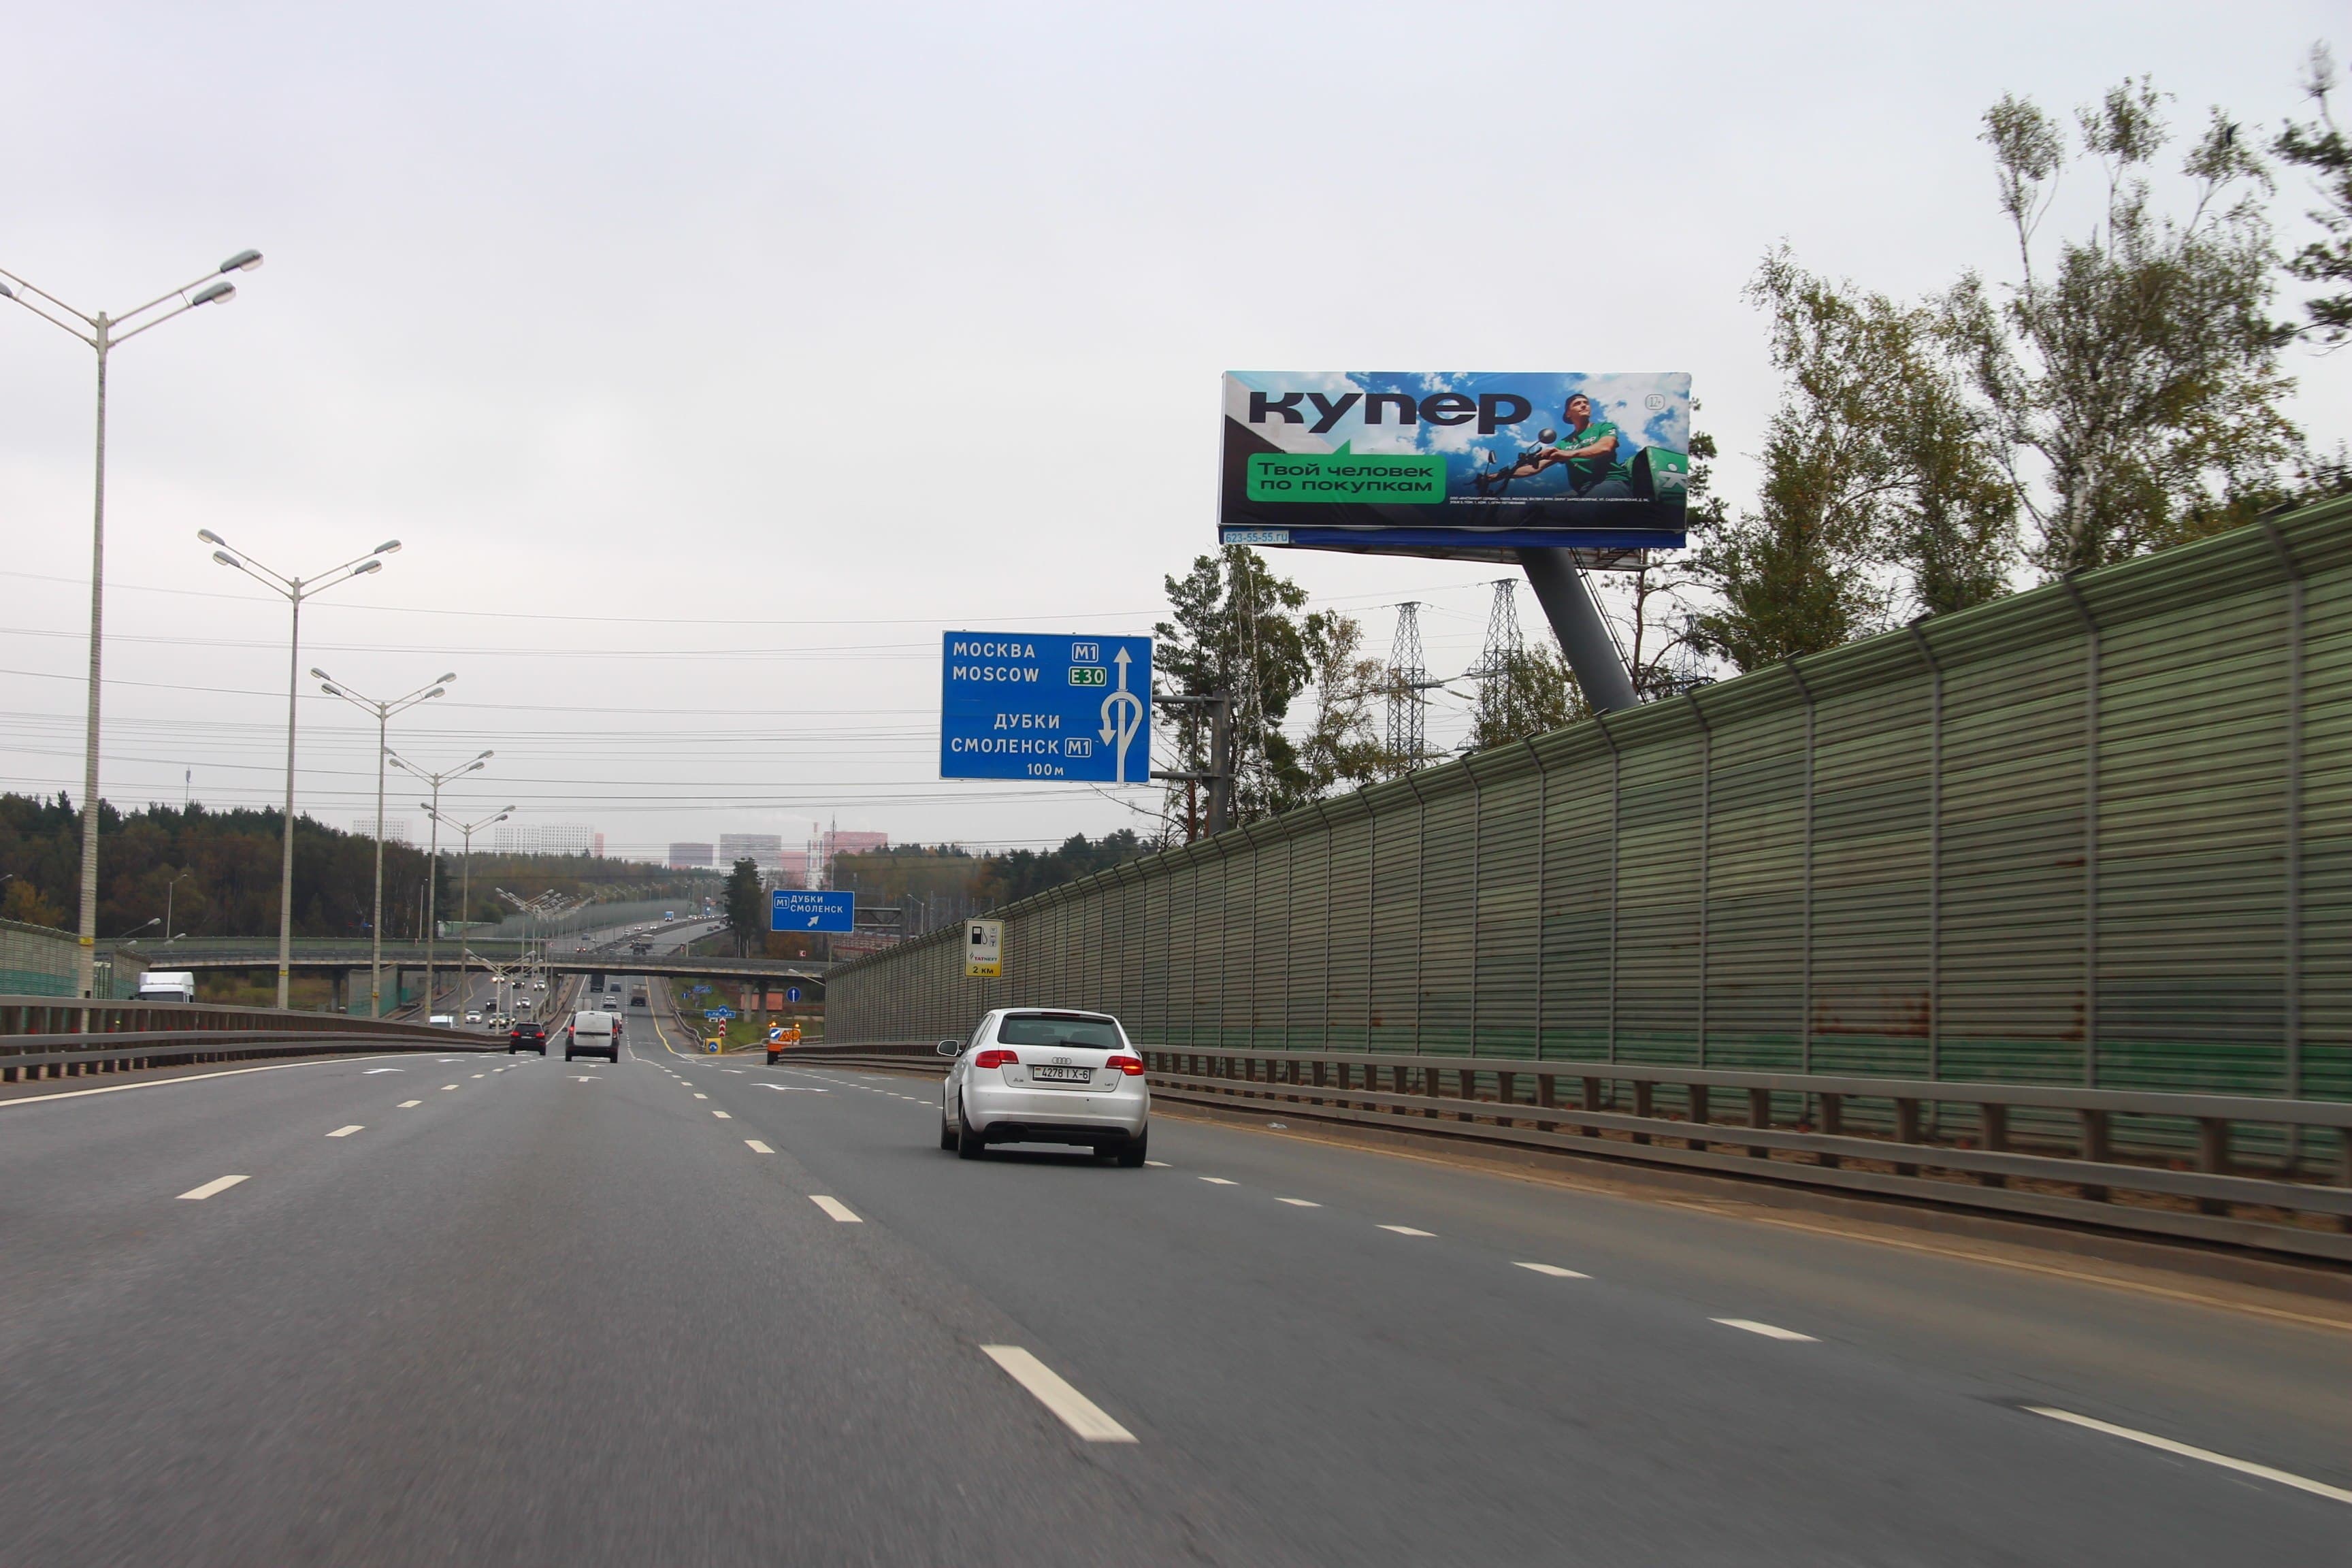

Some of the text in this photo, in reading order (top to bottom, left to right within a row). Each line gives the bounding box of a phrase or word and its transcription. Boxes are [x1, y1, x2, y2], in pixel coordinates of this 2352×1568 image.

[1249, 391, 1532, 434] купер
[1257, 462, 1434, 477] Твой человек
[1260, 480, 1433, 493] по покупкам
[1226, 532, 1288, 542] 623-55-55.ru
[953, 642, 1035, 658] МОСКВА
[953, 666, 1039, 682] MOSCOW
[1071, 670, 1104, 683] E30
[994, 714, 1060, 730] ДУБКИ
[951, 738, 1059, 753] СМОЛЕНСК
[791, 895, 823, 904] ДУБКИ
[1042, 1068, 1063, 1077] 4278
